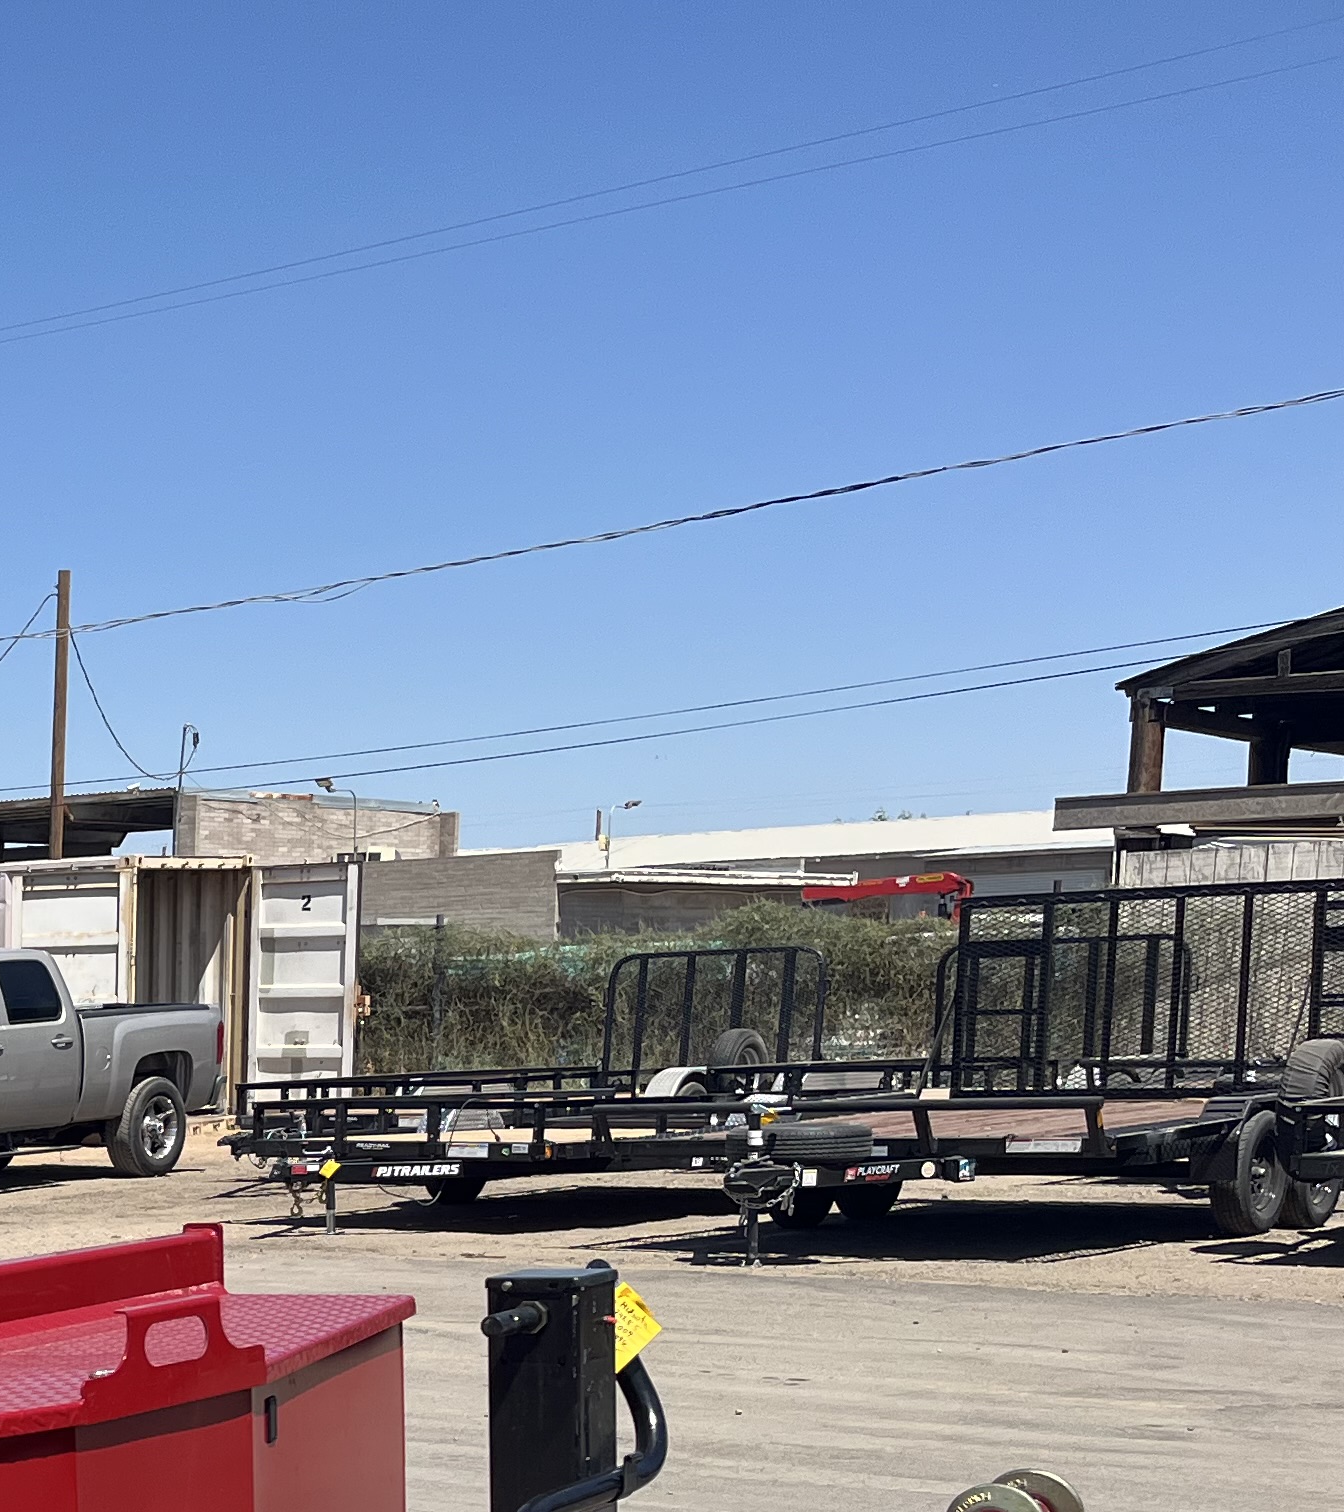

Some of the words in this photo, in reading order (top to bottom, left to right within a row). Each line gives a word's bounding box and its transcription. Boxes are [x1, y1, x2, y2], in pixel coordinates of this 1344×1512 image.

[301, 895, 311, 911] 2
[375, 1166, 393, 1177] PJ
[393, 1163, 461, 1177] TRAILERS
[857, 1164, 900, 1176] PLAYCRAFT
